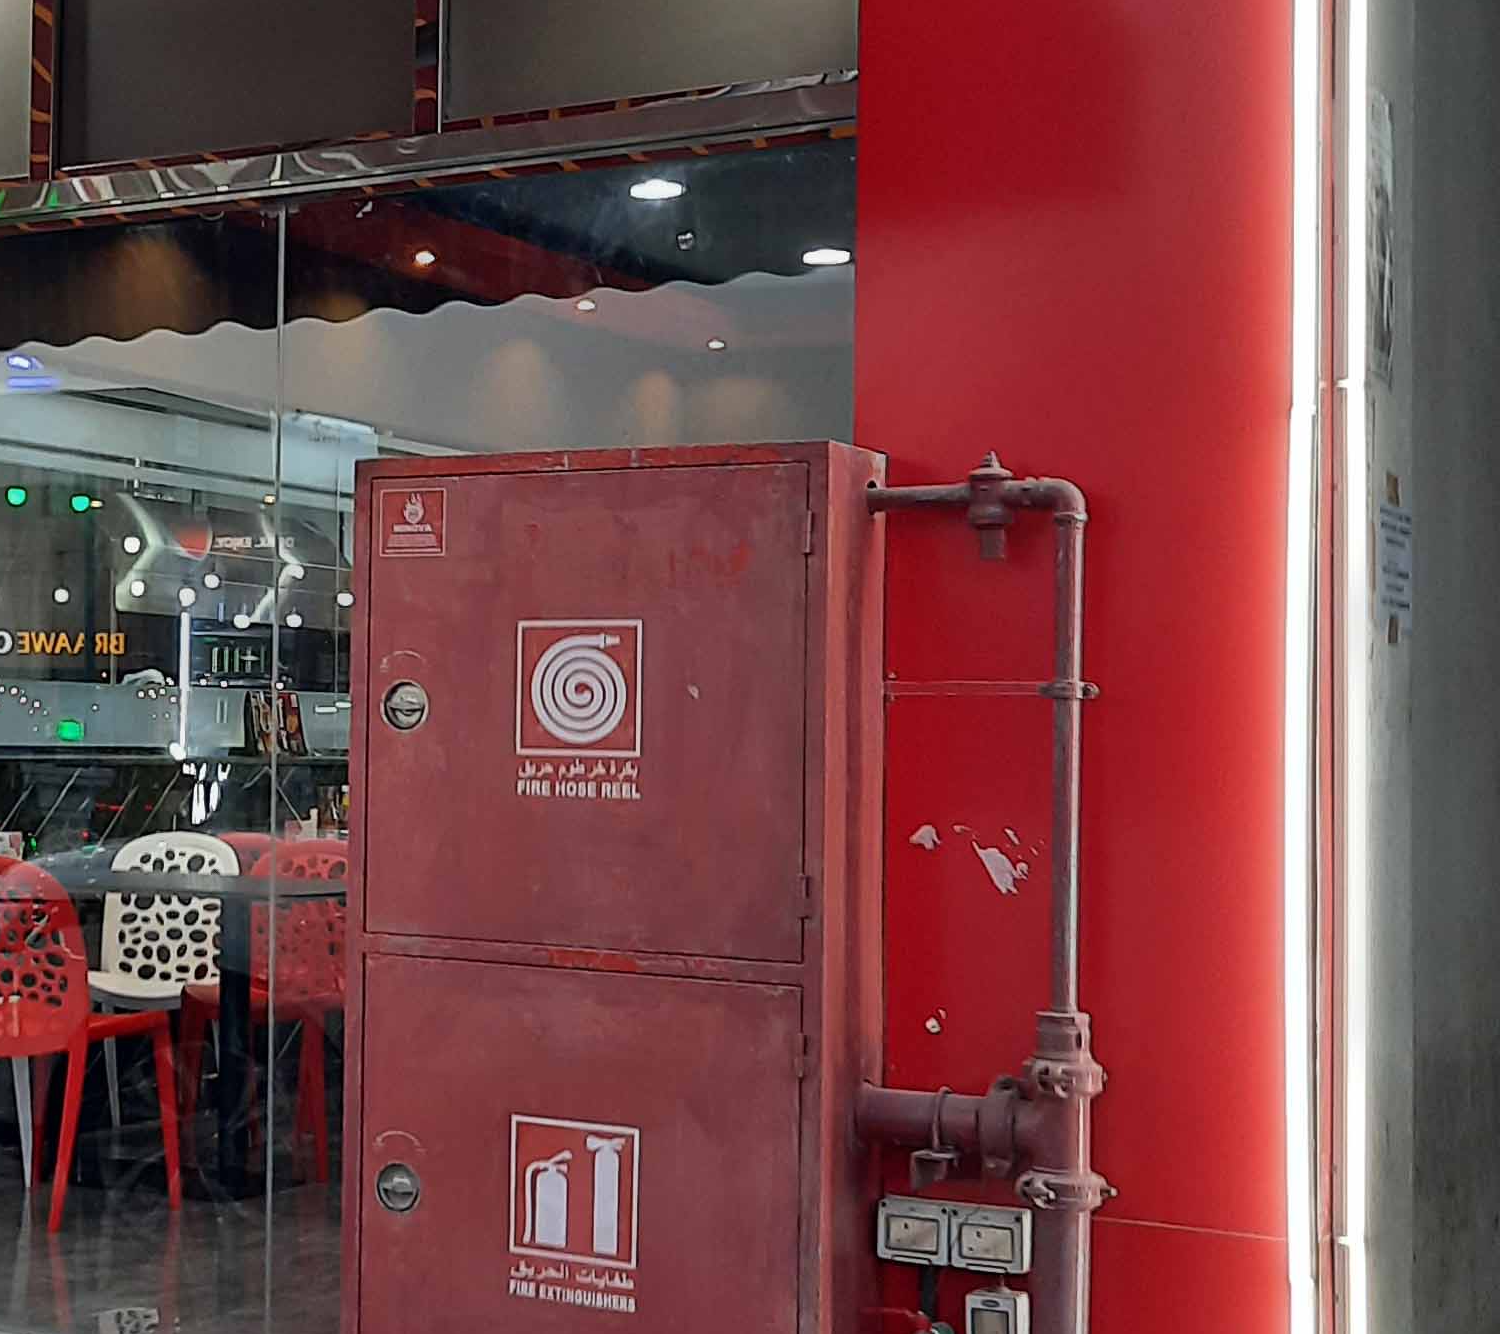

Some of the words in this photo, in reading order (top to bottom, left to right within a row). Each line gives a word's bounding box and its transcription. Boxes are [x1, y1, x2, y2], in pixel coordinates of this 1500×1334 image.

[517, 779, 551, 796] FIRE
[555, 780, 597, 798] HOSE
[601, 781, 640, 799] REEL
[509, 1279, 536, 1298] FIRE
